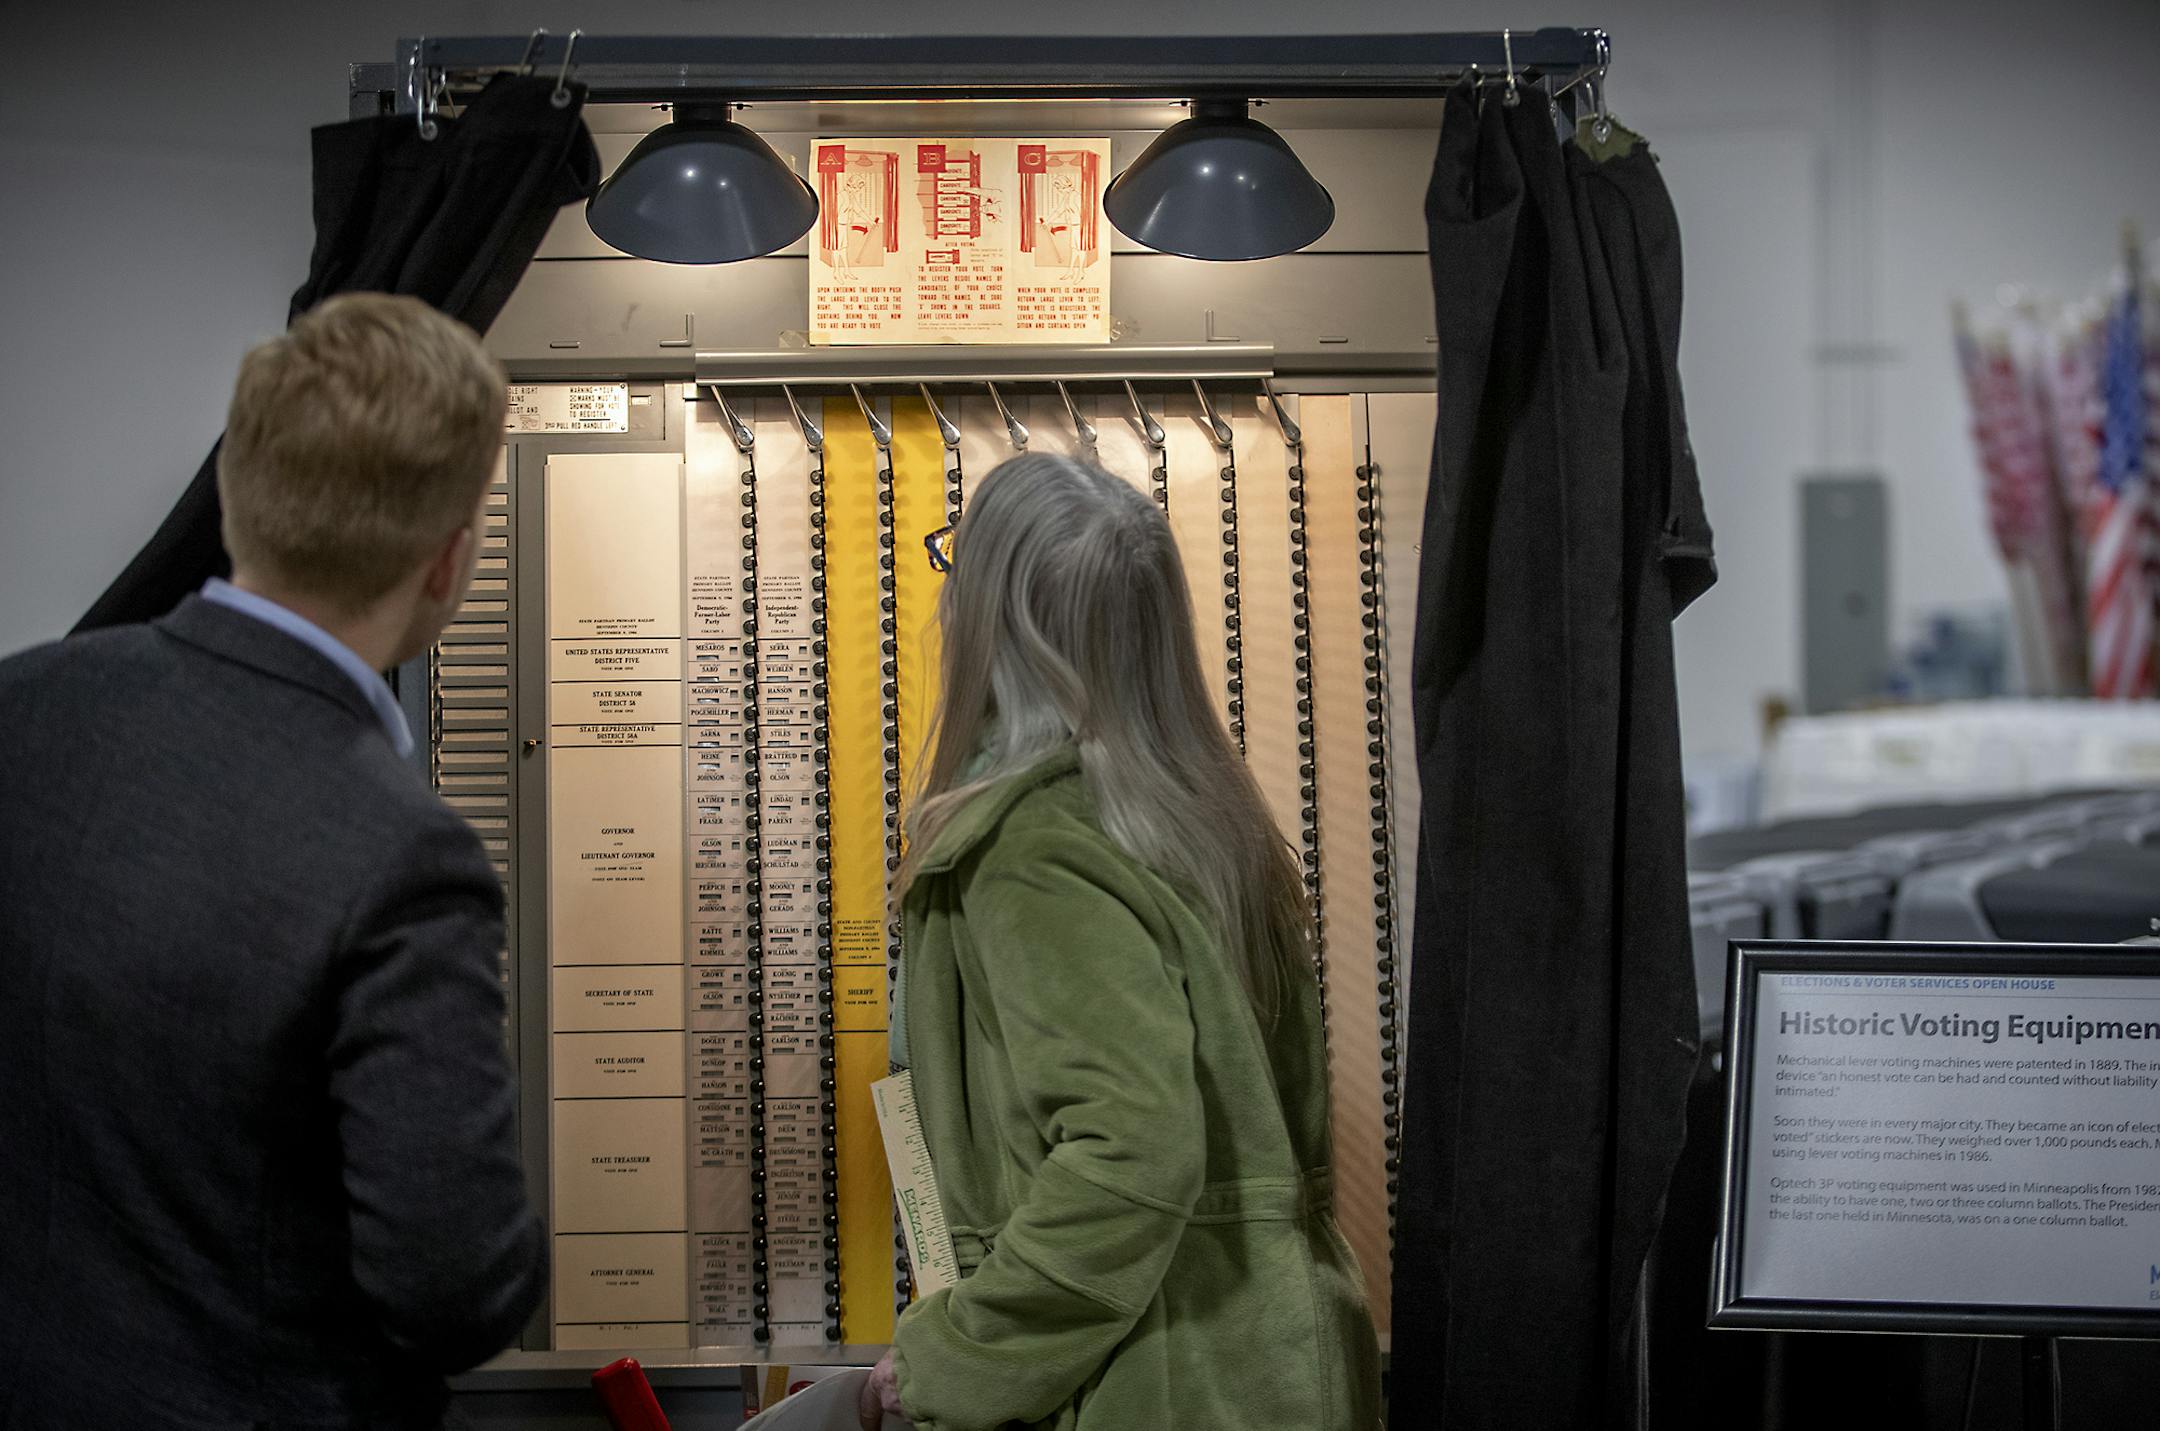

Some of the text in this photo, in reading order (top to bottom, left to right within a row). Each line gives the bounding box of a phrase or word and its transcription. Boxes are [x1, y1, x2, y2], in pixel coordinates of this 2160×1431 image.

[923, 152, 940, 165] B
[1023, 152, 1041, 165] C
[1781, 977, 2056, 990] ELECTIONS & VOTER SERVICES OPEN HOUSE
[633, 989, 654, 997] STATE
[1780, 1011, 2160, 1045] Historic Voting Equipmen
[1776, 1054, 2147, 1071] Mechanical lever voting machines were patented in 1889. The
[1776, 1069, 1815, 1082] device
[1840, 1071, 1881, 1083] honest
[1884, 1072, 1911, 1083] vote
[1913, 1074, 1935, 1083] can
[1938, 1072, 1954, 1083] be
[1956, 1073, 1980, 1084] had
[1982, 1074, 2006, 1084] and
[2008, 1074, 2060, 1085] counted
[2062, 1075, 2110, 1086] without
[2113, 1075, 2158, 1089] liability
[1773, 1114, 2131, 1133] Soon they were in every major city. They became an icon of
[1815, 1132, 1860, 1144] stickers
[1862, 1135, 1882, 1144] are
[1884, 1136, 1914, 1145] now.
[1915, 1133, 1945, 1148] They
[1948, 1135, 2001, 1149] weighed
[2004, 1138, 2032, 1147] over
[2035, 1136, 2067, 1148] 1,000
[2069, 1137, 2117, 1150] pounds
[2119, 1138, 2152, 1149] each.
[1772, 1148, 1992, 1163] using lever voting machines in 1986.
[1770, 1176, 2131, 1196] Optech 3P voting equipment was used in Minneapolis from
[1770, 1194, 1791, 1204] the
[1793, 1194, 1829, 1207] ability
[1833, 1195, 1846, 1206] to
[1850, 1195, 1881, 1206] have
[1881, 1197, 1908, 1208] one,
[1910, 1196, 1934, 1207] two
[1936, 1199, 1951, 1208] or
[1952, 1197, 1985, 1208] three
[1987, 1198, 2034, 1209] column
[2037, 1199, 2081, 1210] ballots.
[2083, 1200, 2106, 1211] The
[1769, 1208, 2128, 1227] the last one held in Minnesota, was on a one column ballot.
[590, 1269, 624, 1277] ATTORNEY
